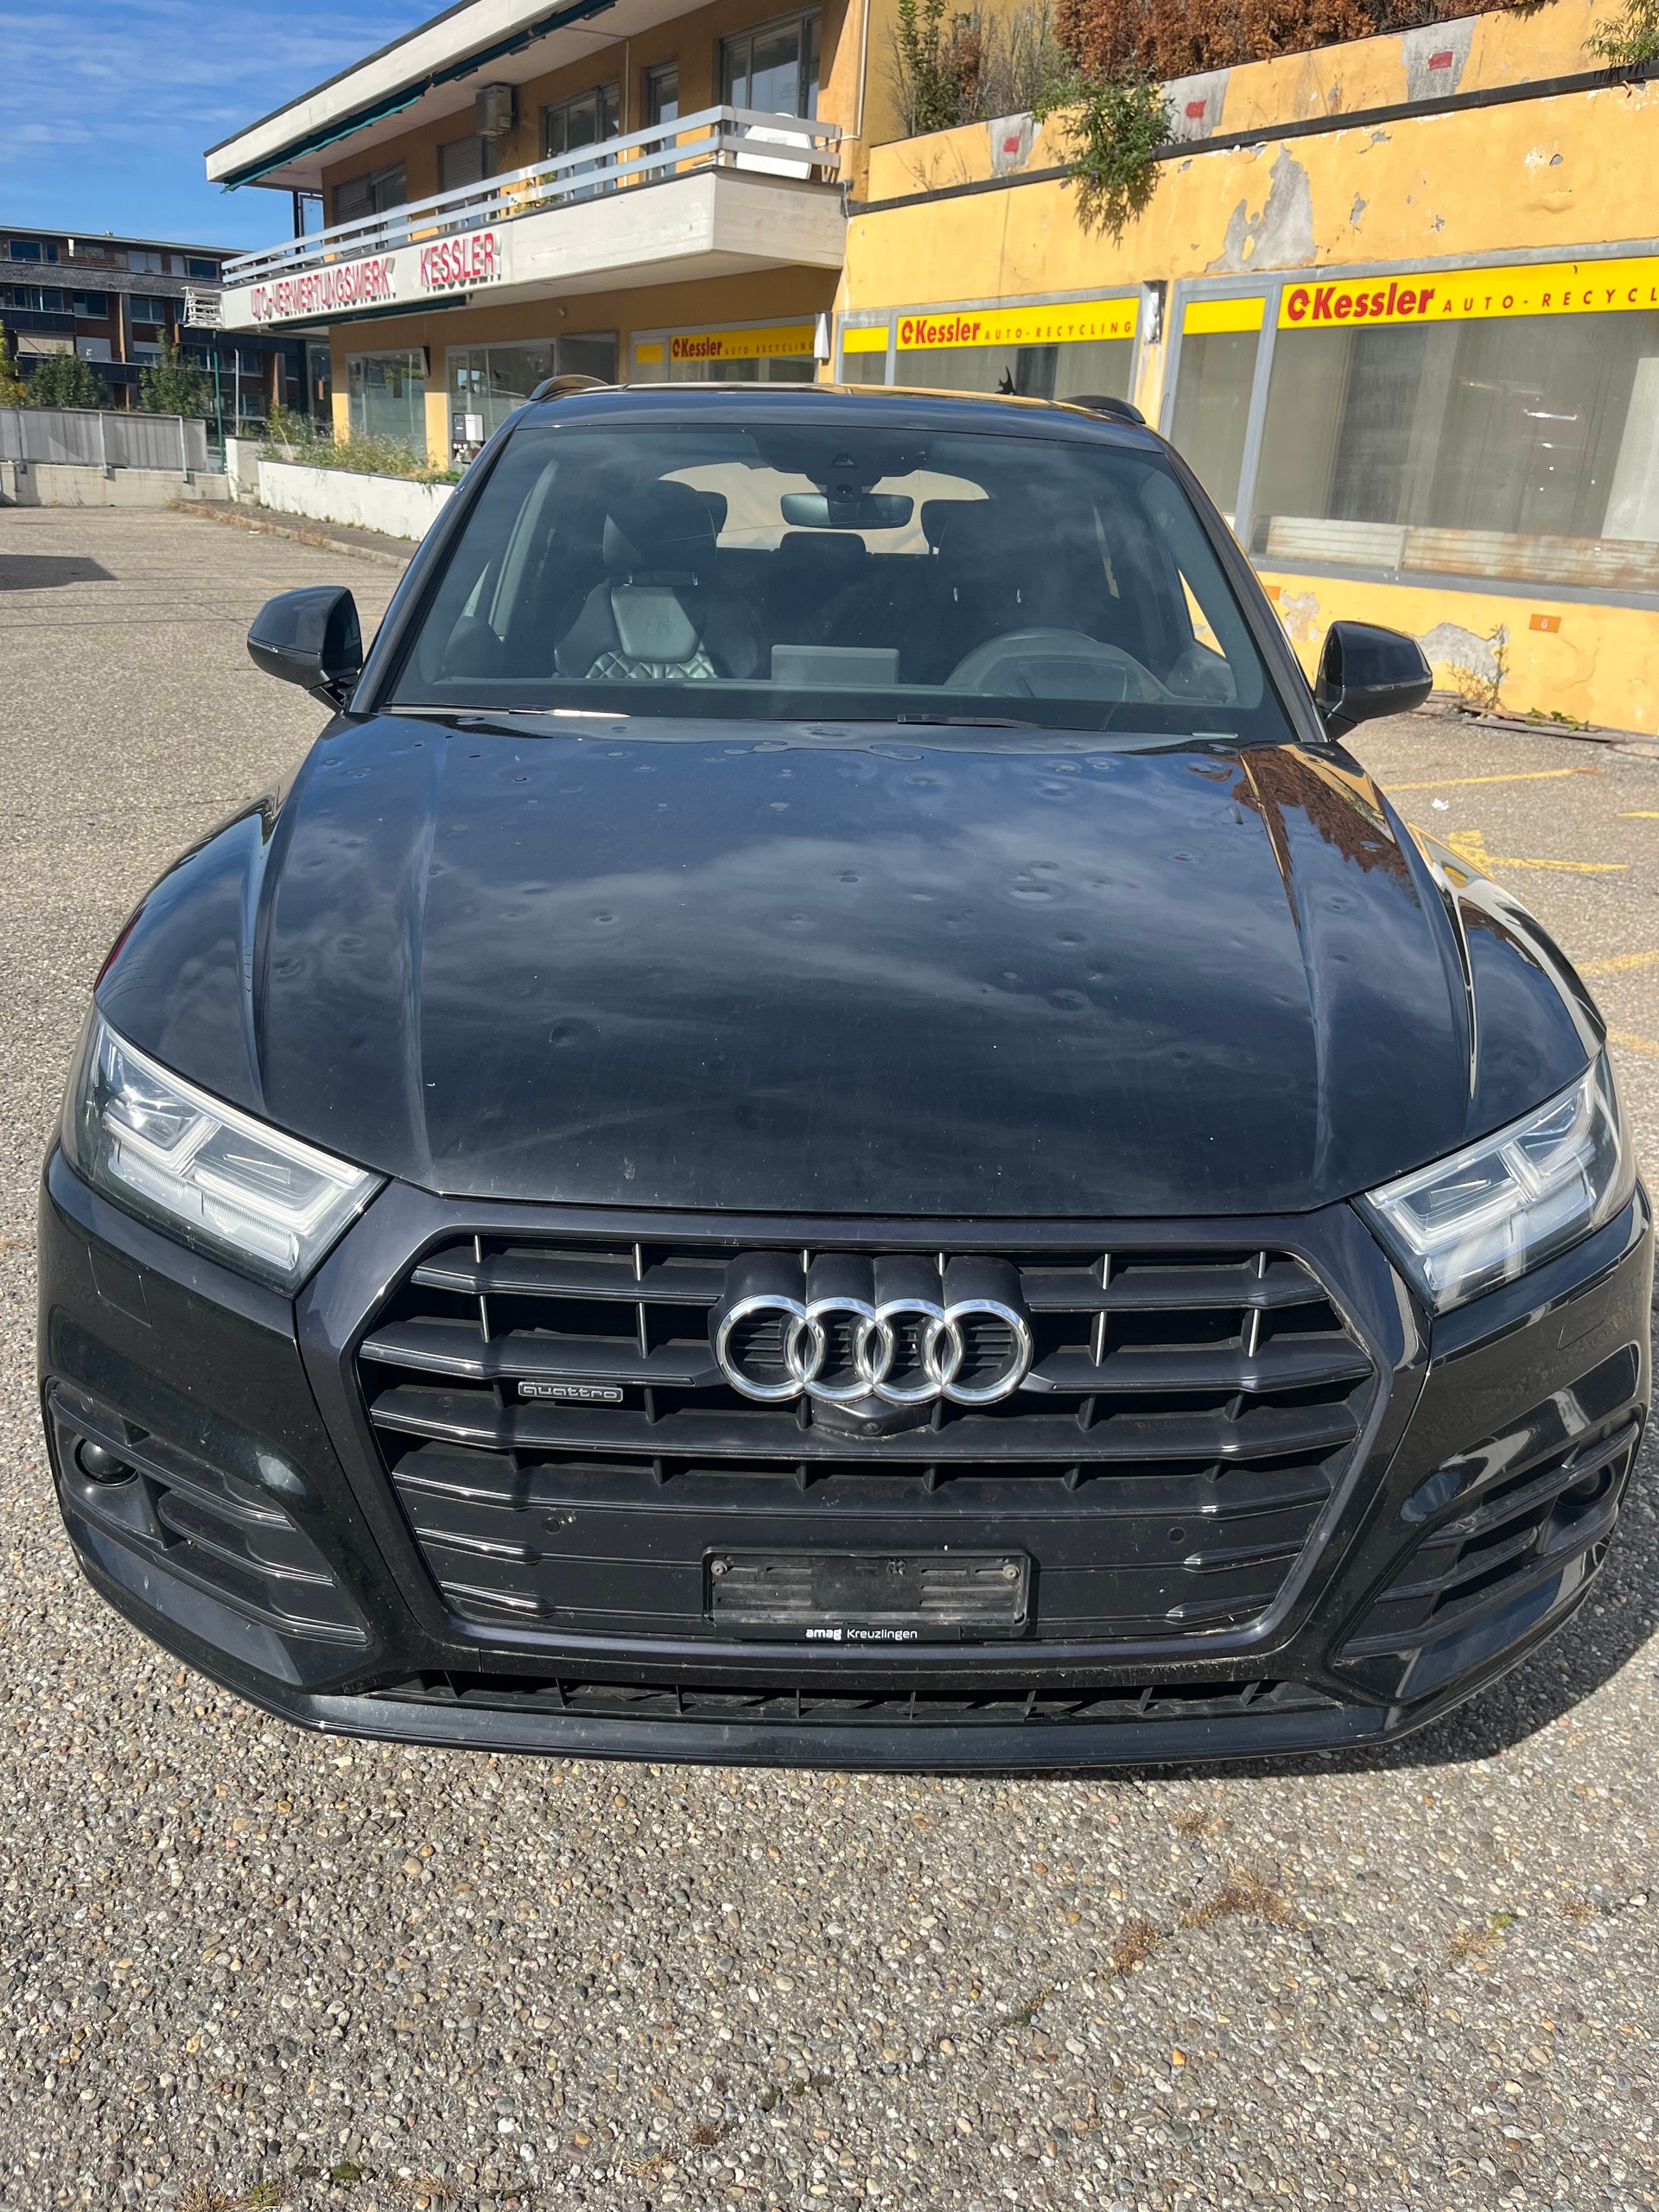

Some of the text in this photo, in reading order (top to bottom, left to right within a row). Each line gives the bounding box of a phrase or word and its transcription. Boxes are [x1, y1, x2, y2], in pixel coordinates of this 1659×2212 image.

[421, 232, 497, 286] KESSLER
[1313, 283, 1435, 320] Kessler
[915, 317, 1132, 344] Kessler AUTO-RECYCLING
[681, 337, 722, 357] Kessler
[523, 1385, 618, 1399] quattro
[805, 1628, 918, 1641] amag Kreuzlingen
